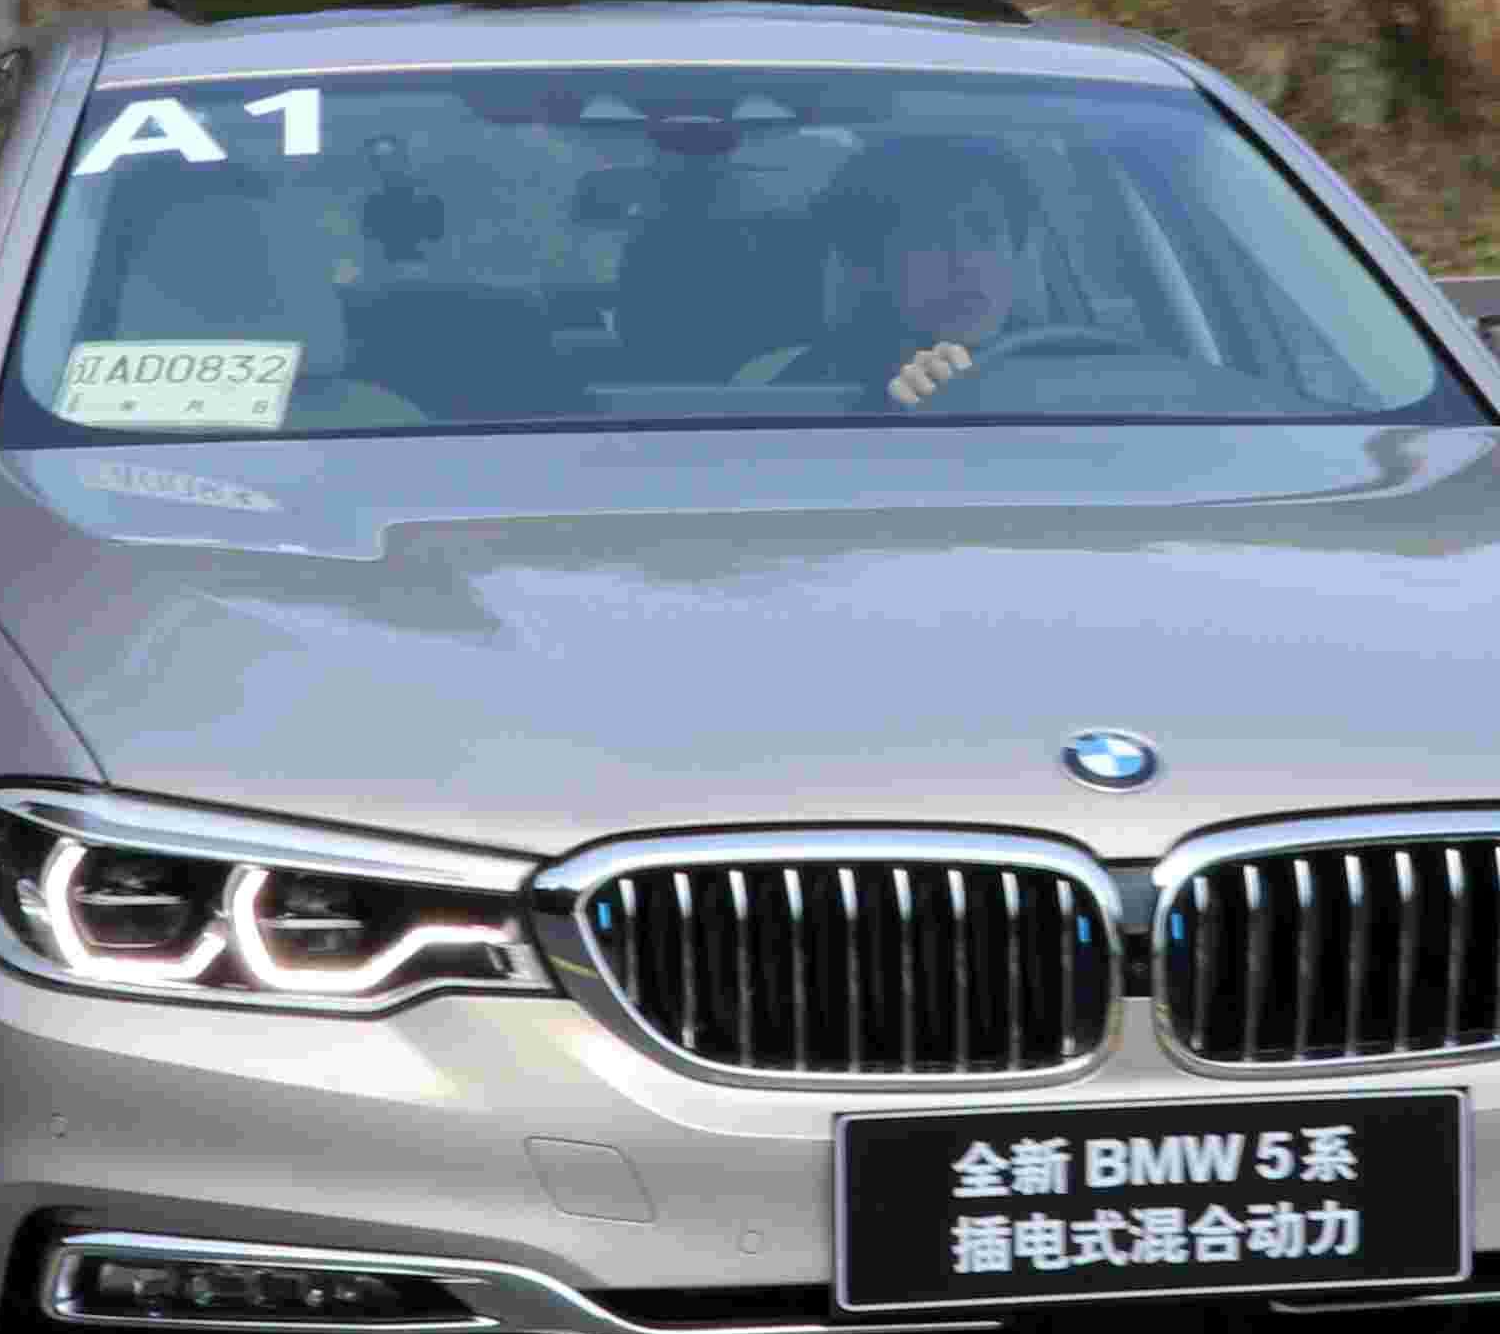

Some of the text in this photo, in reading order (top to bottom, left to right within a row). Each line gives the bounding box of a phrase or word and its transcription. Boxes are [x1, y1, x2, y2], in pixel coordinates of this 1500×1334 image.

[72, 87, 323, 176] A1
[950, 1124, 1359, 1198] 全新 BMW 5系
[950, 1200, 1361, 1274] 插电式混合动力
